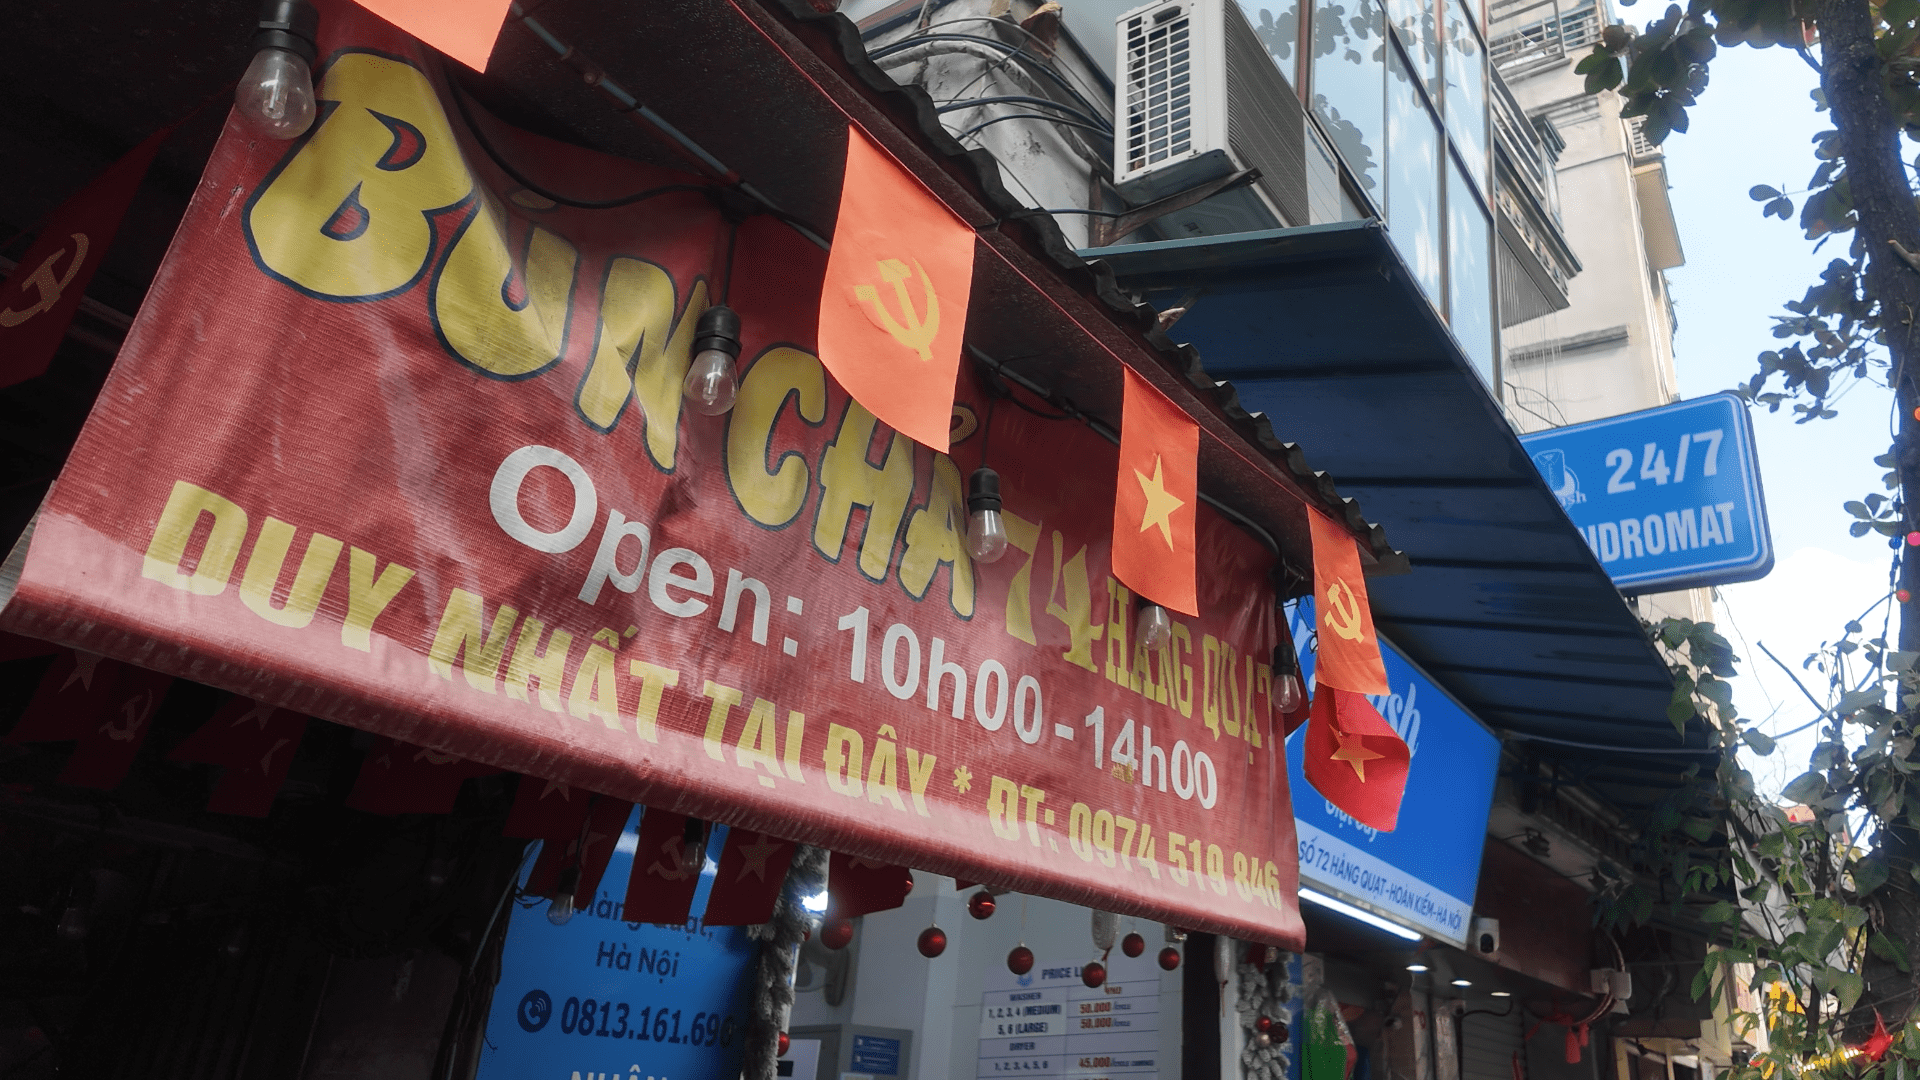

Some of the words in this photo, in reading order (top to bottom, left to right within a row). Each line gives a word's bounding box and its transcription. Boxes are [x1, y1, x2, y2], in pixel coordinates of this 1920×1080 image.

[1605, 429, 1724, 495] 24/7
[724, 342, 978, 621] CHẢ
[1001, 507, 1104, 674] 74
[1578, 501, 1735, 563] NDROMAT
[489, 445, 804, 658] Open:
[142, 480, 415, 653] DUY
[428, 587, 680, 743] NHẤT
[703, 679, 805, 788] TẠI
[823, 724, 937, 818] ĐÂY
[987, 775, 1059, 853] ĐT:
[1069, 802, 1160, 879] 0974
[1168, 832, 1227, 896] 519
[1233, 852, 1281, 912] 846
[1299, 836, 1317, 863] SỐ
[1315, 848, 1330, 871] 72
[596, 941, 632, 971] Hà
[637, 947, 679, 984] Nội
[1041, 967, 1072, 979] PRICE
[1015, 1022, 1048, 1034] (LARGE)
[1023, 1004, 1062, 1017] (MEDIUM)
